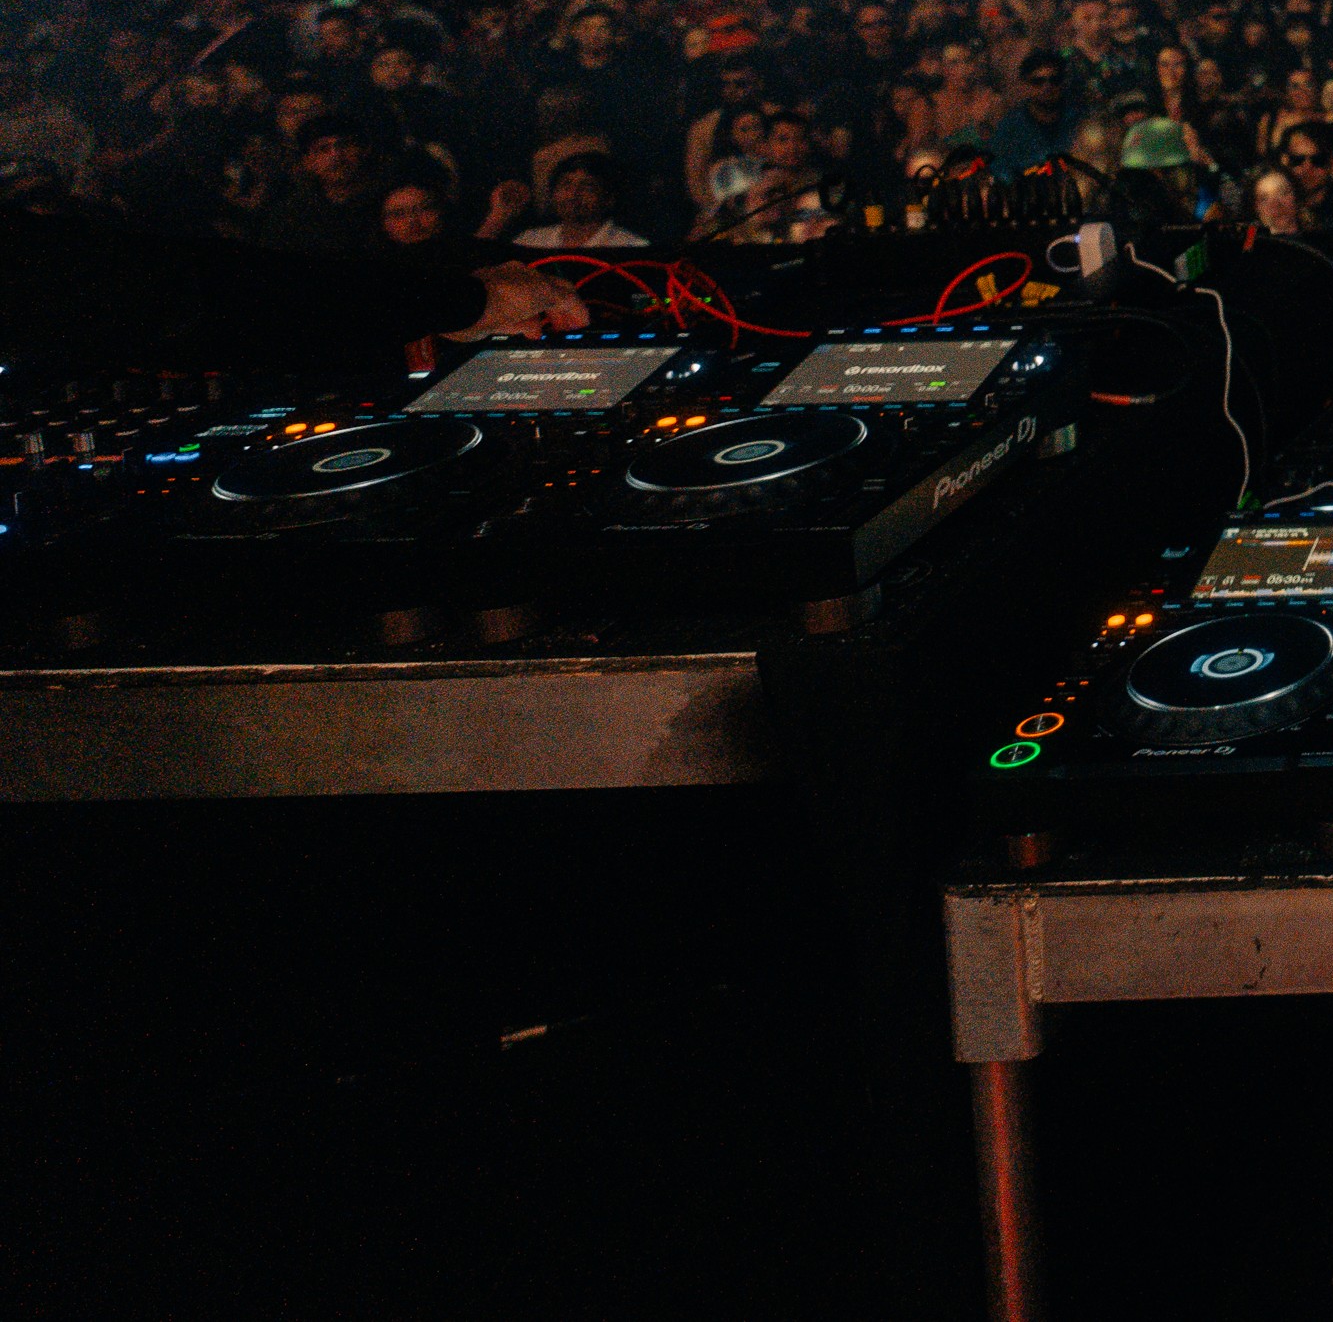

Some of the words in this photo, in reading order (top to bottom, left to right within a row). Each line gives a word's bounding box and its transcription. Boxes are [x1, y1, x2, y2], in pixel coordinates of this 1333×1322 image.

[859, 364, 947, 375] rekordbox
[932, 431, 1014, 509] Pioneer
[1017, 415, 1037, 443] DJ
[1132, 748, 1212, 757] Pioneer
